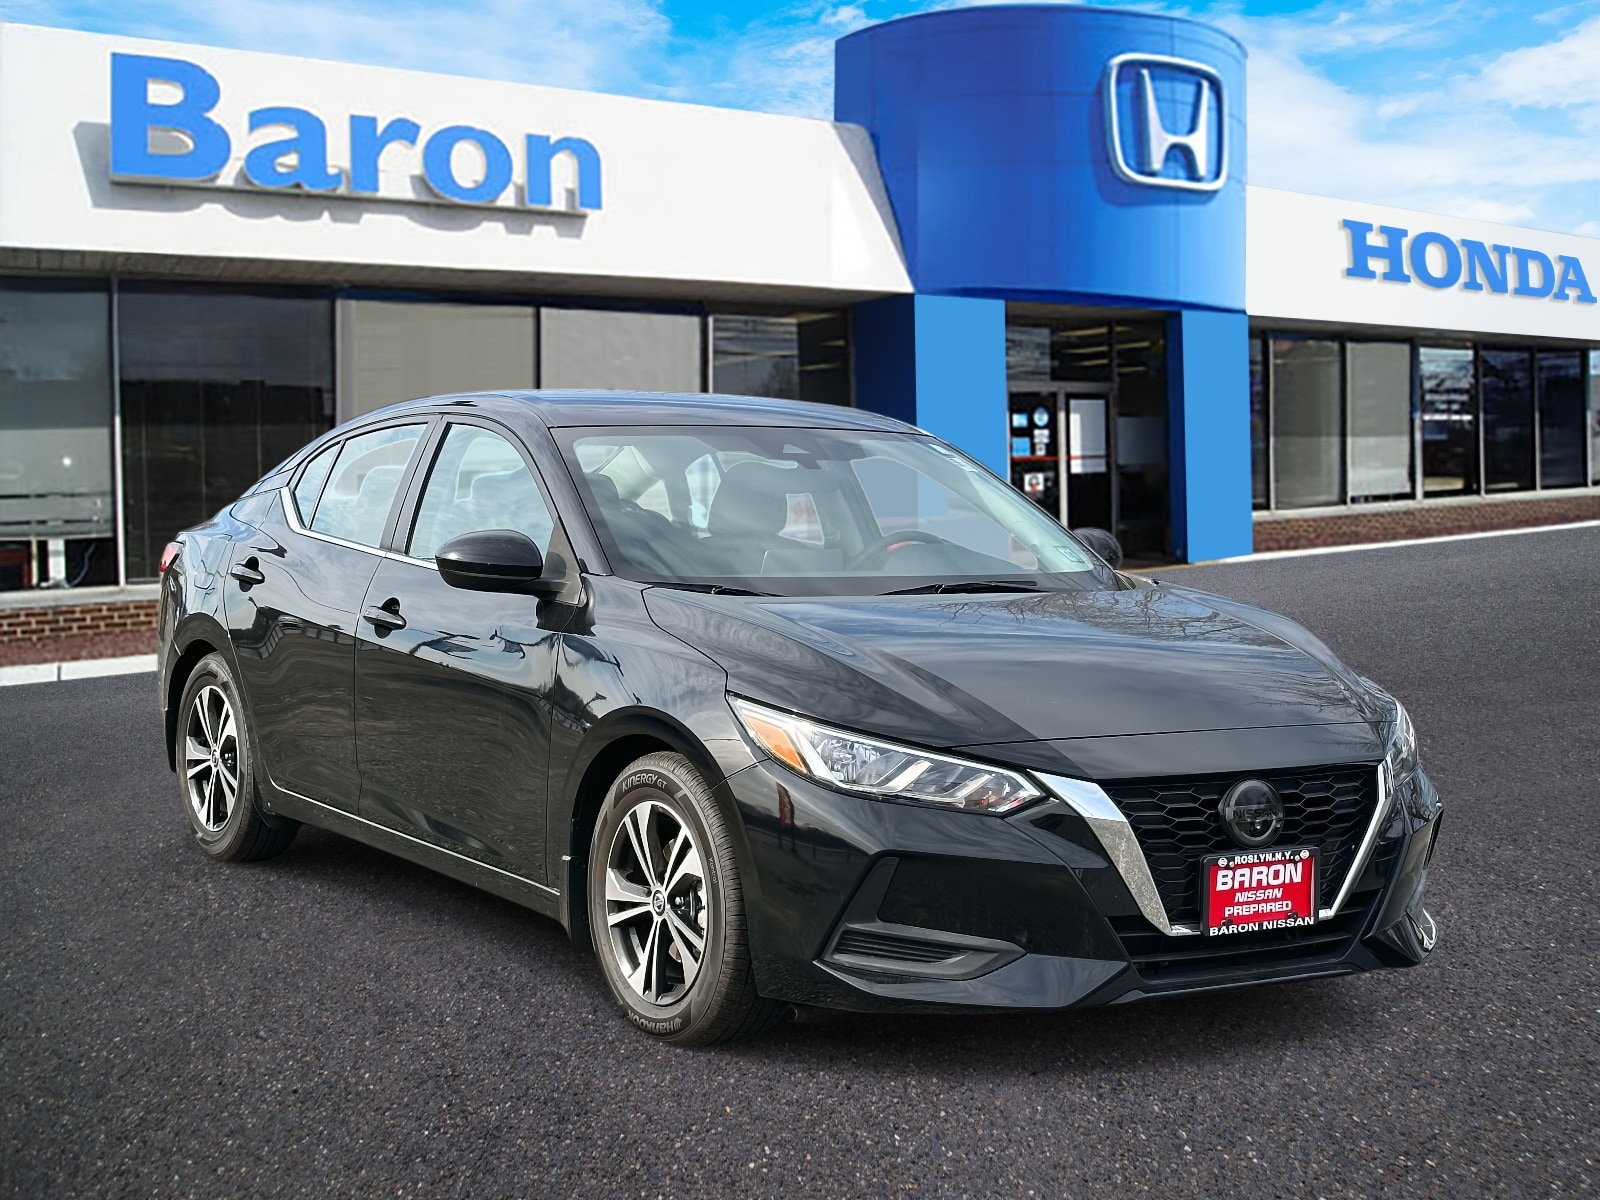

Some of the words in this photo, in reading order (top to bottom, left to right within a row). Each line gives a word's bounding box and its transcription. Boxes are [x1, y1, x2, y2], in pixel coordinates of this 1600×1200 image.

[110, 52, 603, 211] Baron
[1342, 219, 1597, 305] HONDA
[1216, 862, 1302, 890] BARON
[1234, 888, 1283, 903] NISSAN
[1224, 900, 1292, 918] PREPARED
[1209, 922, 1259, 937] BARON
[1262, 916, 1315, 930] NISSAN
